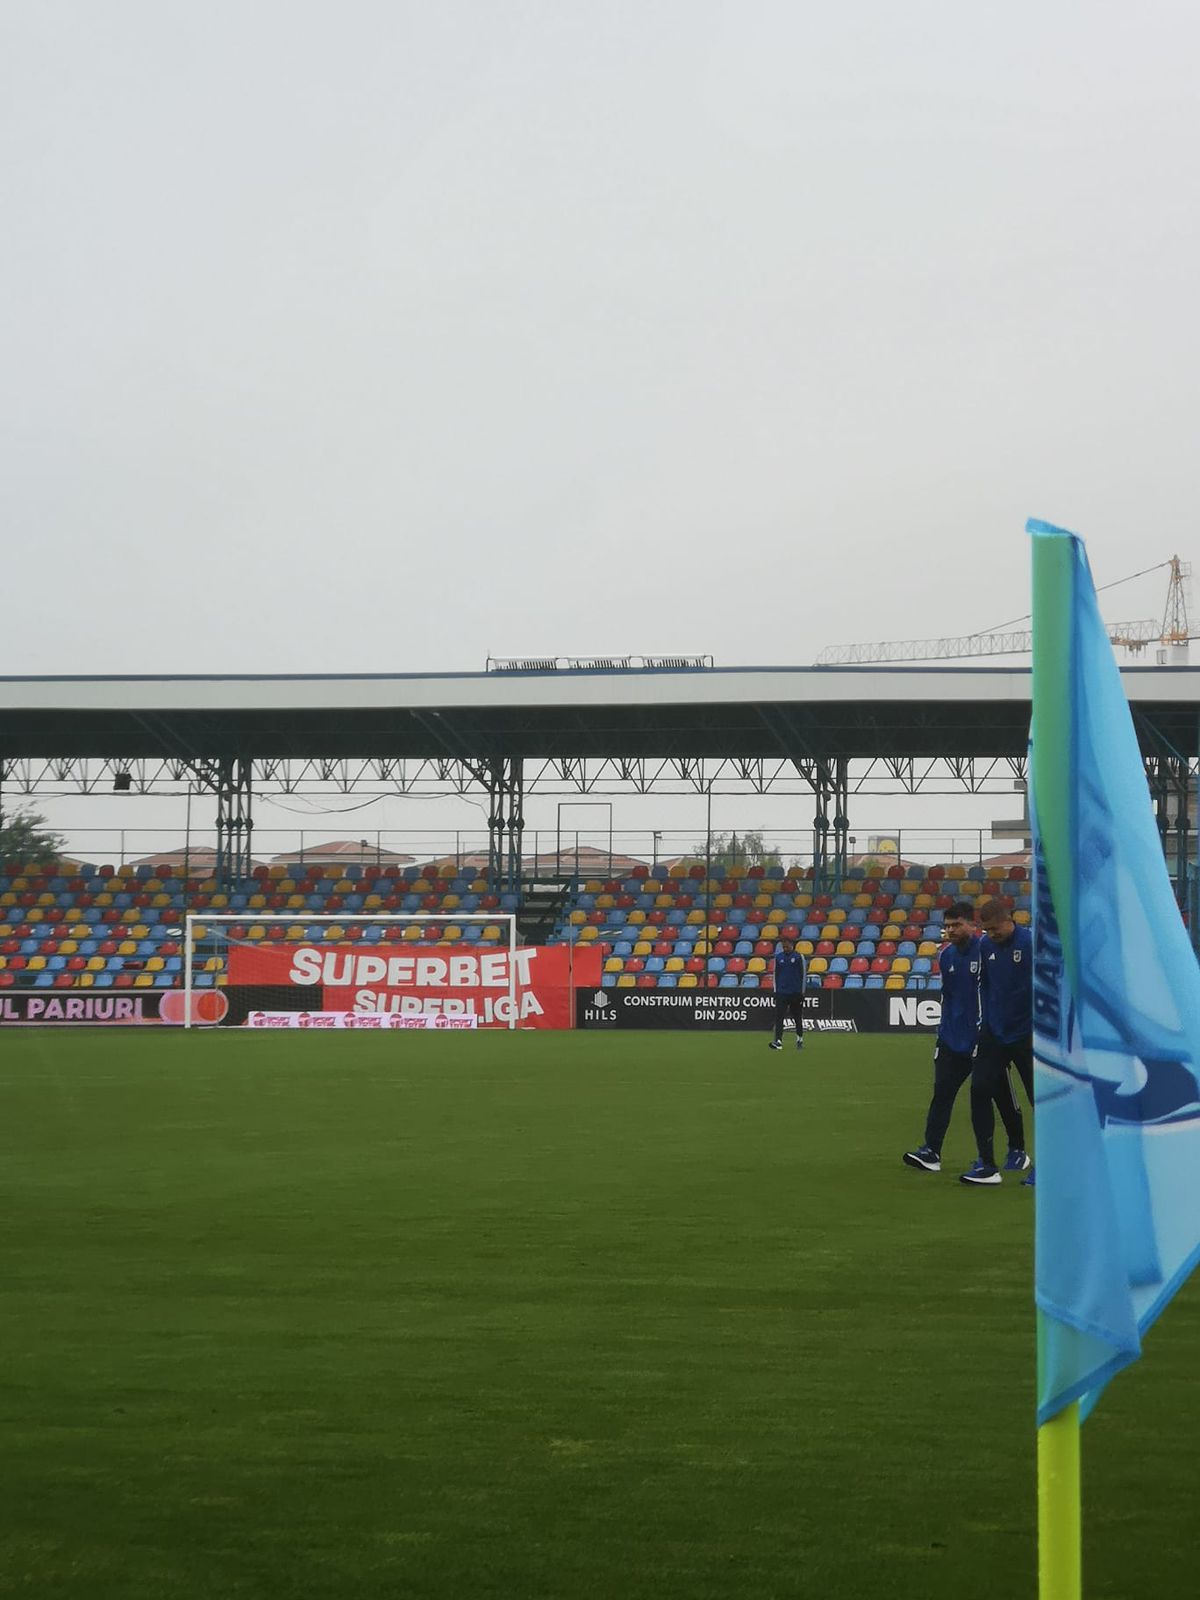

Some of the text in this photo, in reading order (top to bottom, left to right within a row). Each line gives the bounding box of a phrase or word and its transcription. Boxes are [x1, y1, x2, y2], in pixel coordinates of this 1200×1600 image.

[289, 948, 537, 986] SUPERBET
[0, 998, 142, 1020] L PARIURI
[353, 989, 545, 1024] SUPERLIGA
[624, 996, 692, 1006] CONSTRUIM
[695, 996, 740, 1007] PENTRU
[889, 997, 942, 1026] Ne
[585, 1009, 617, 1020] HILS
[695, 1010, 747, 1021] DIN 2005
